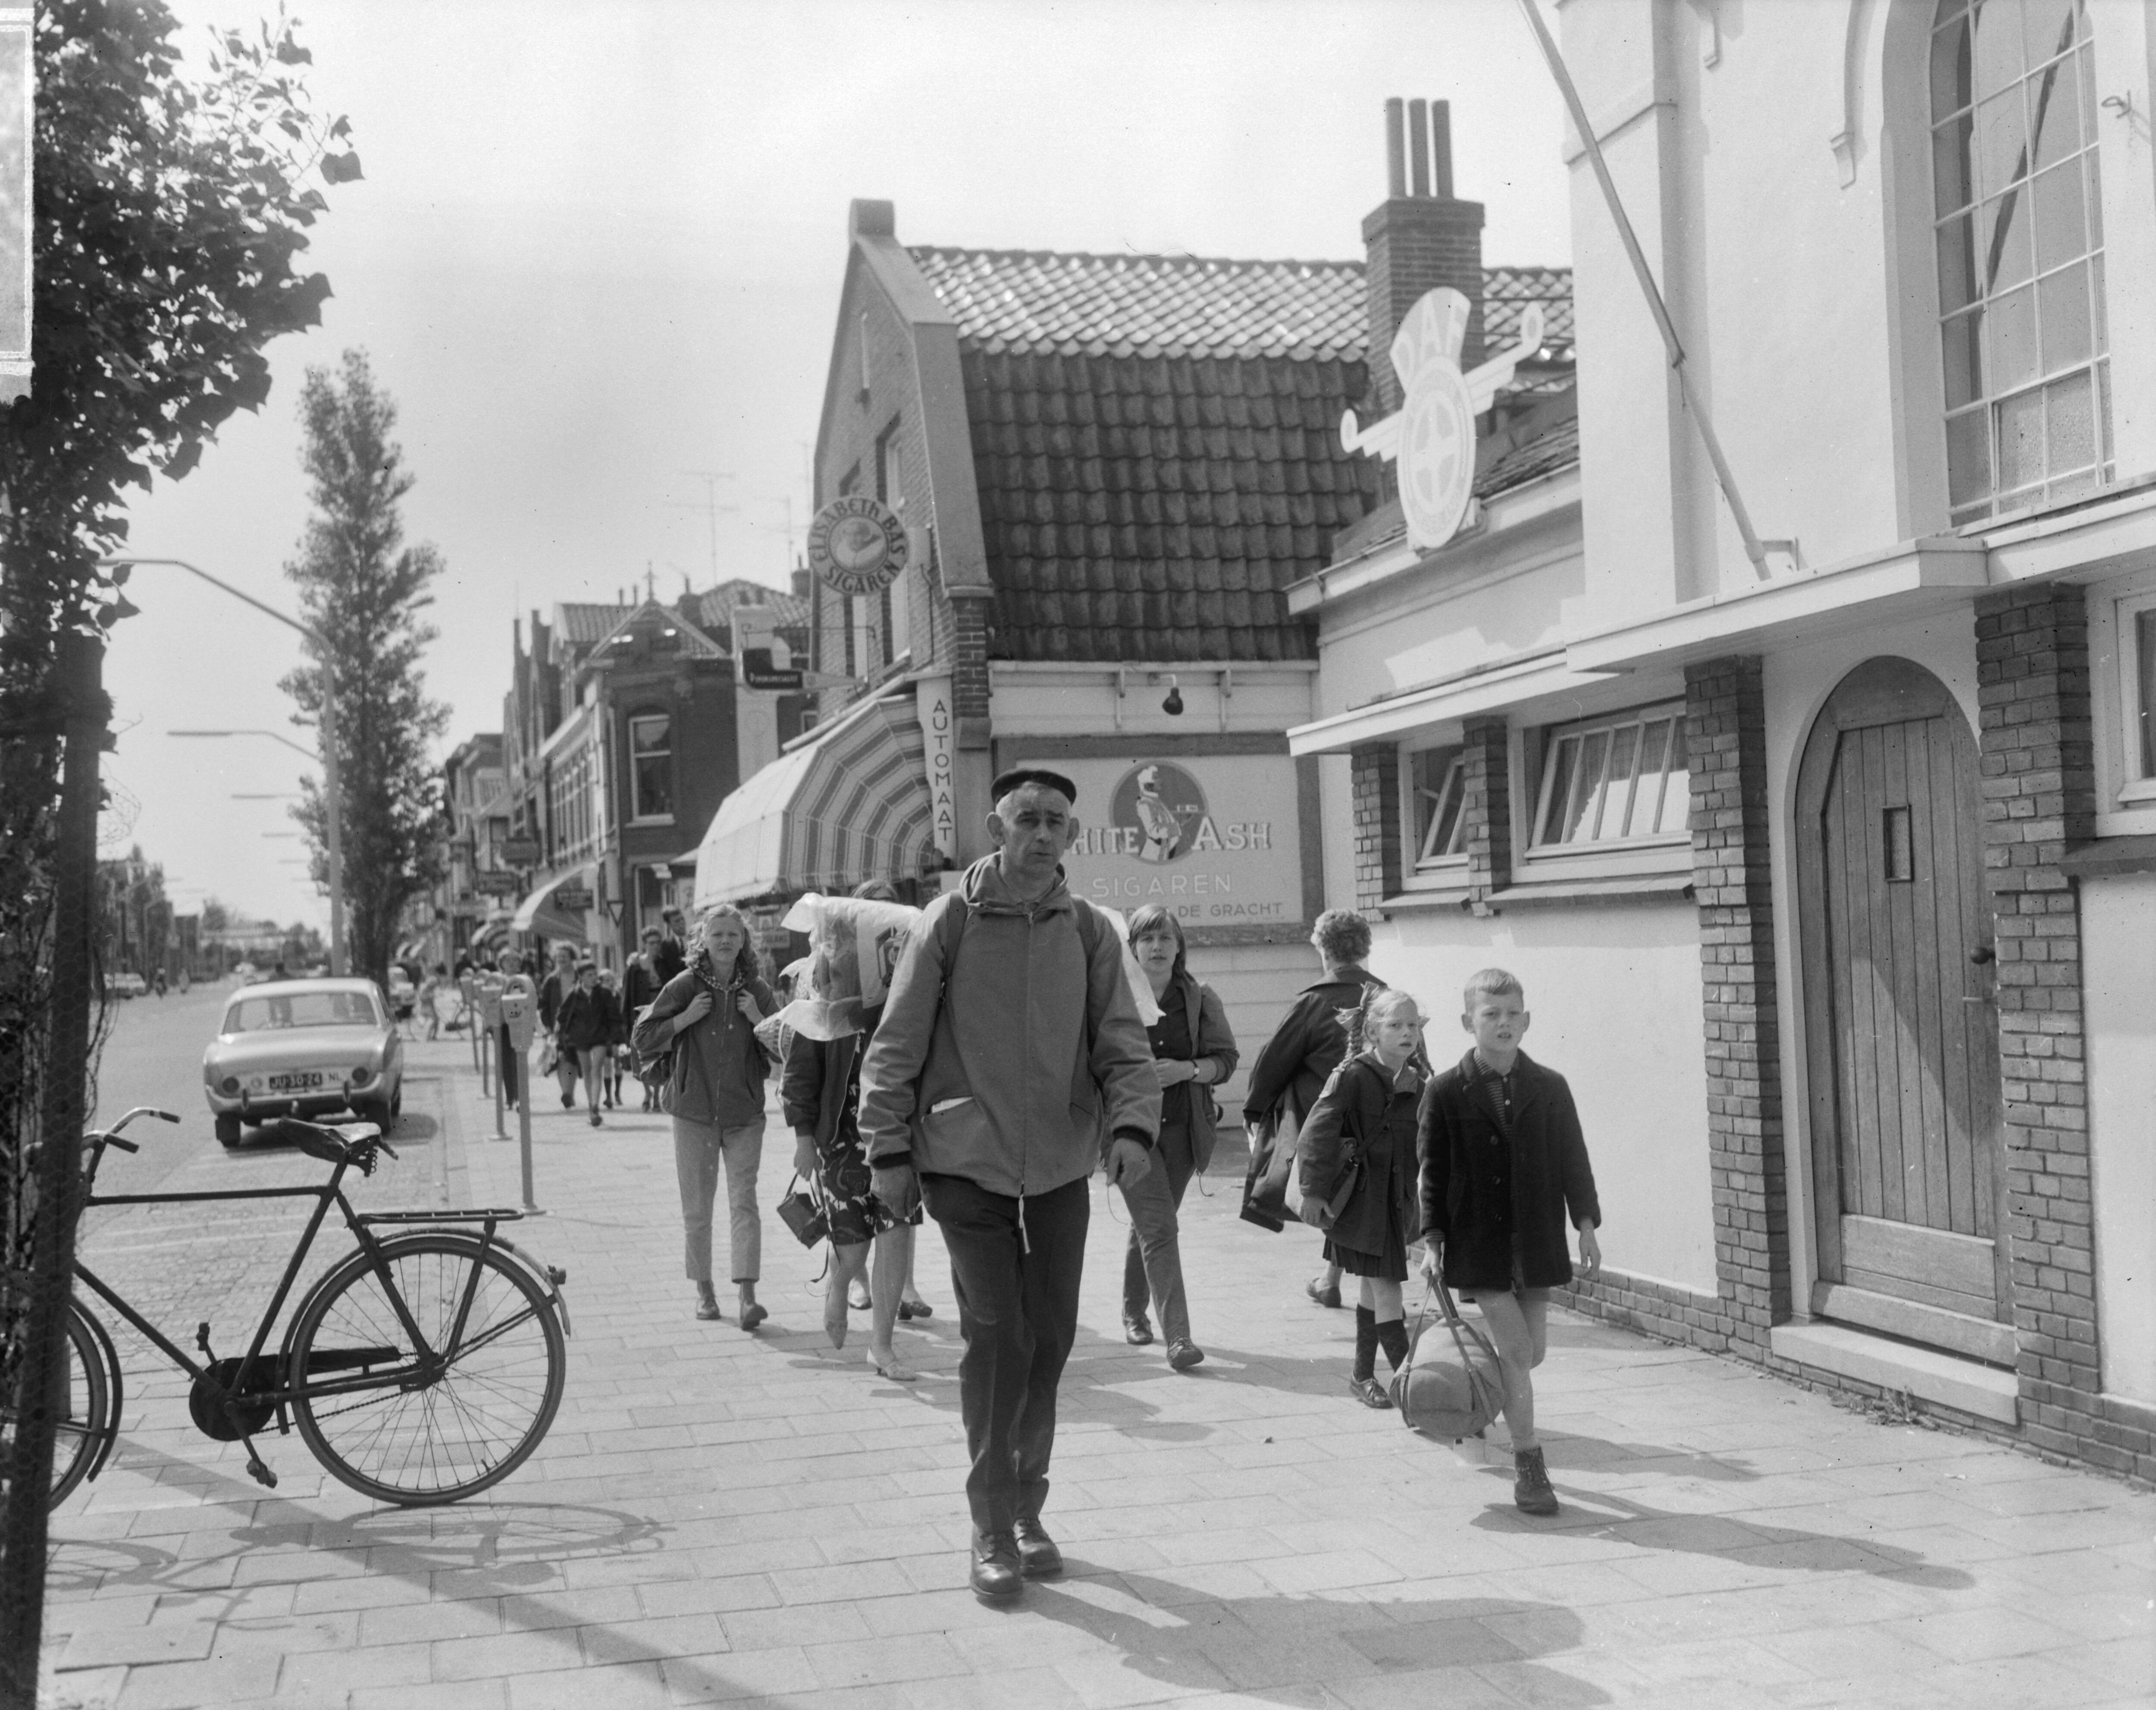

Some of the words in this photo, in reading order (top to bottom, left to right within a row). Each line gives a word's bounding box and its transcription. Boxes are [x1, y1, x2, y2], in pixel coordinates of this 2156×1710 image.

[1391, 290, 1470, 392] DAF
[882, 515, 905, 555] BAS
[824, 560, 900, 593] SIGAREN
[932, 698, 953, 841] AUTOMAAT
[1071, 827, 1139, 855] HITE
[1191, 814, 1272, 851] ASH
[1091, 872, 1232, 898] SIGAREN
[1178, 905, 1200, 918] DE
[1210, 902, 1283, 917] GRACHT
